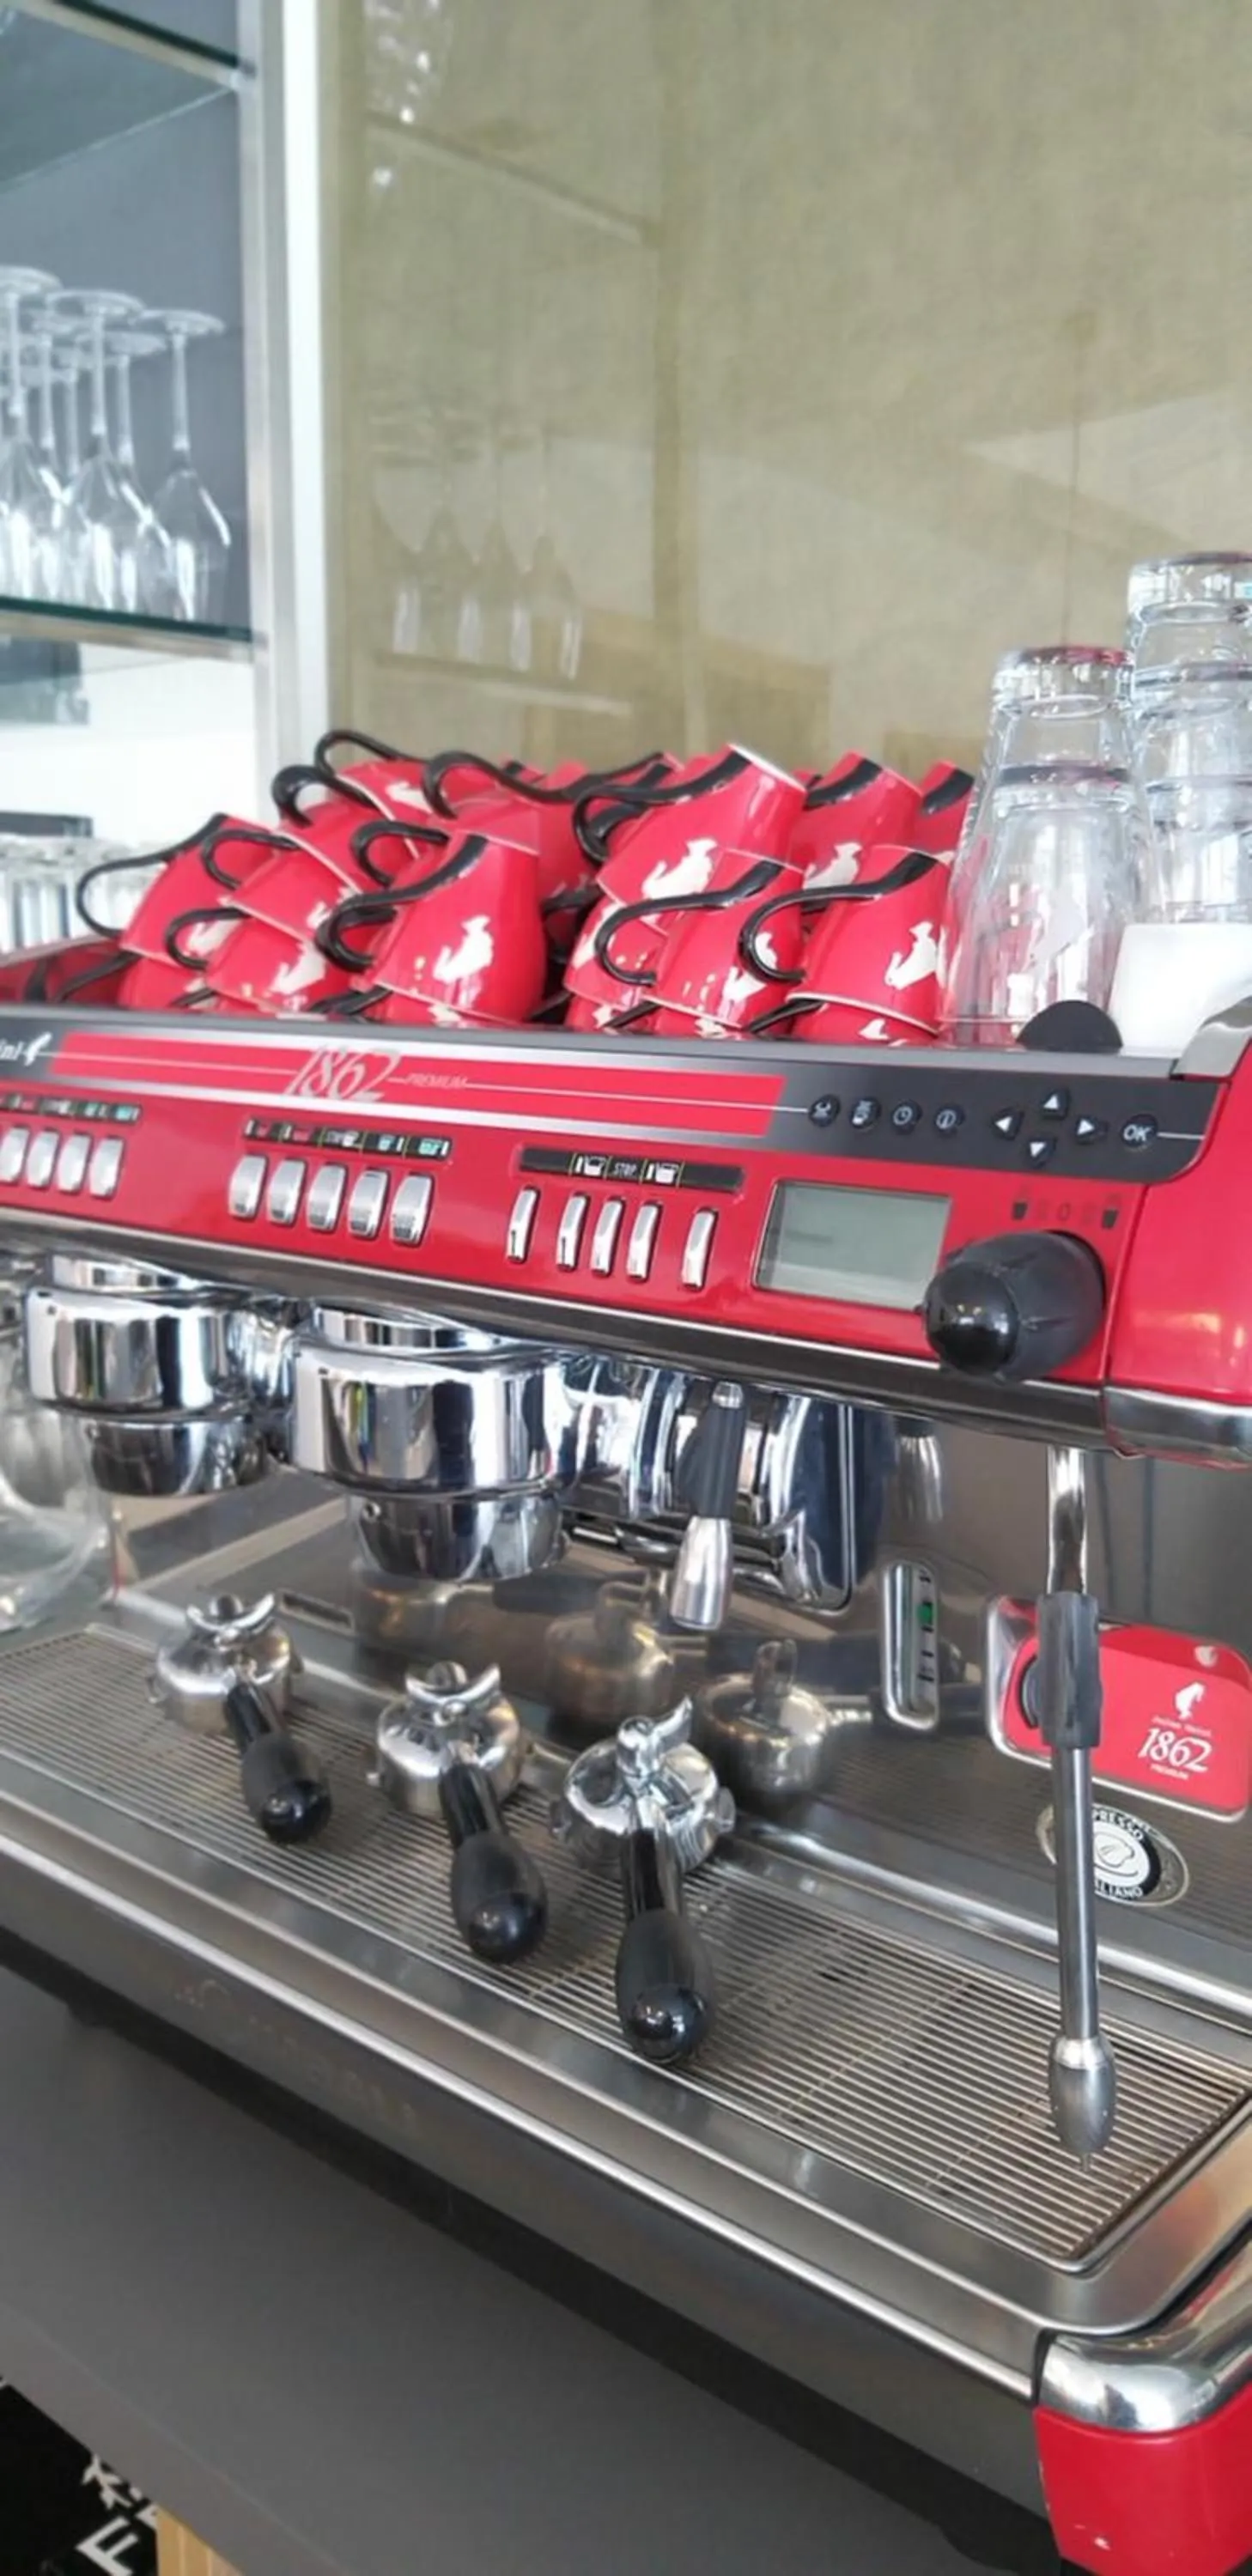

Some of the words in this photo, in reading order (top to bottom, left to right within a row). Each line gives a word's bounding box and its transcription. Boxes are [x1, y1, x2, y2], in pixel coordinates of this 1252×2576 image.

[282, 1045, 401, 1103] 1862
[1123, 1123, 1154, 1142] OK
[613, 1162, 637, 1177] STOP
[1138, 1728, 1212, 1773] 1862
[1092, 1808, 1144, 1840] PRESSO
